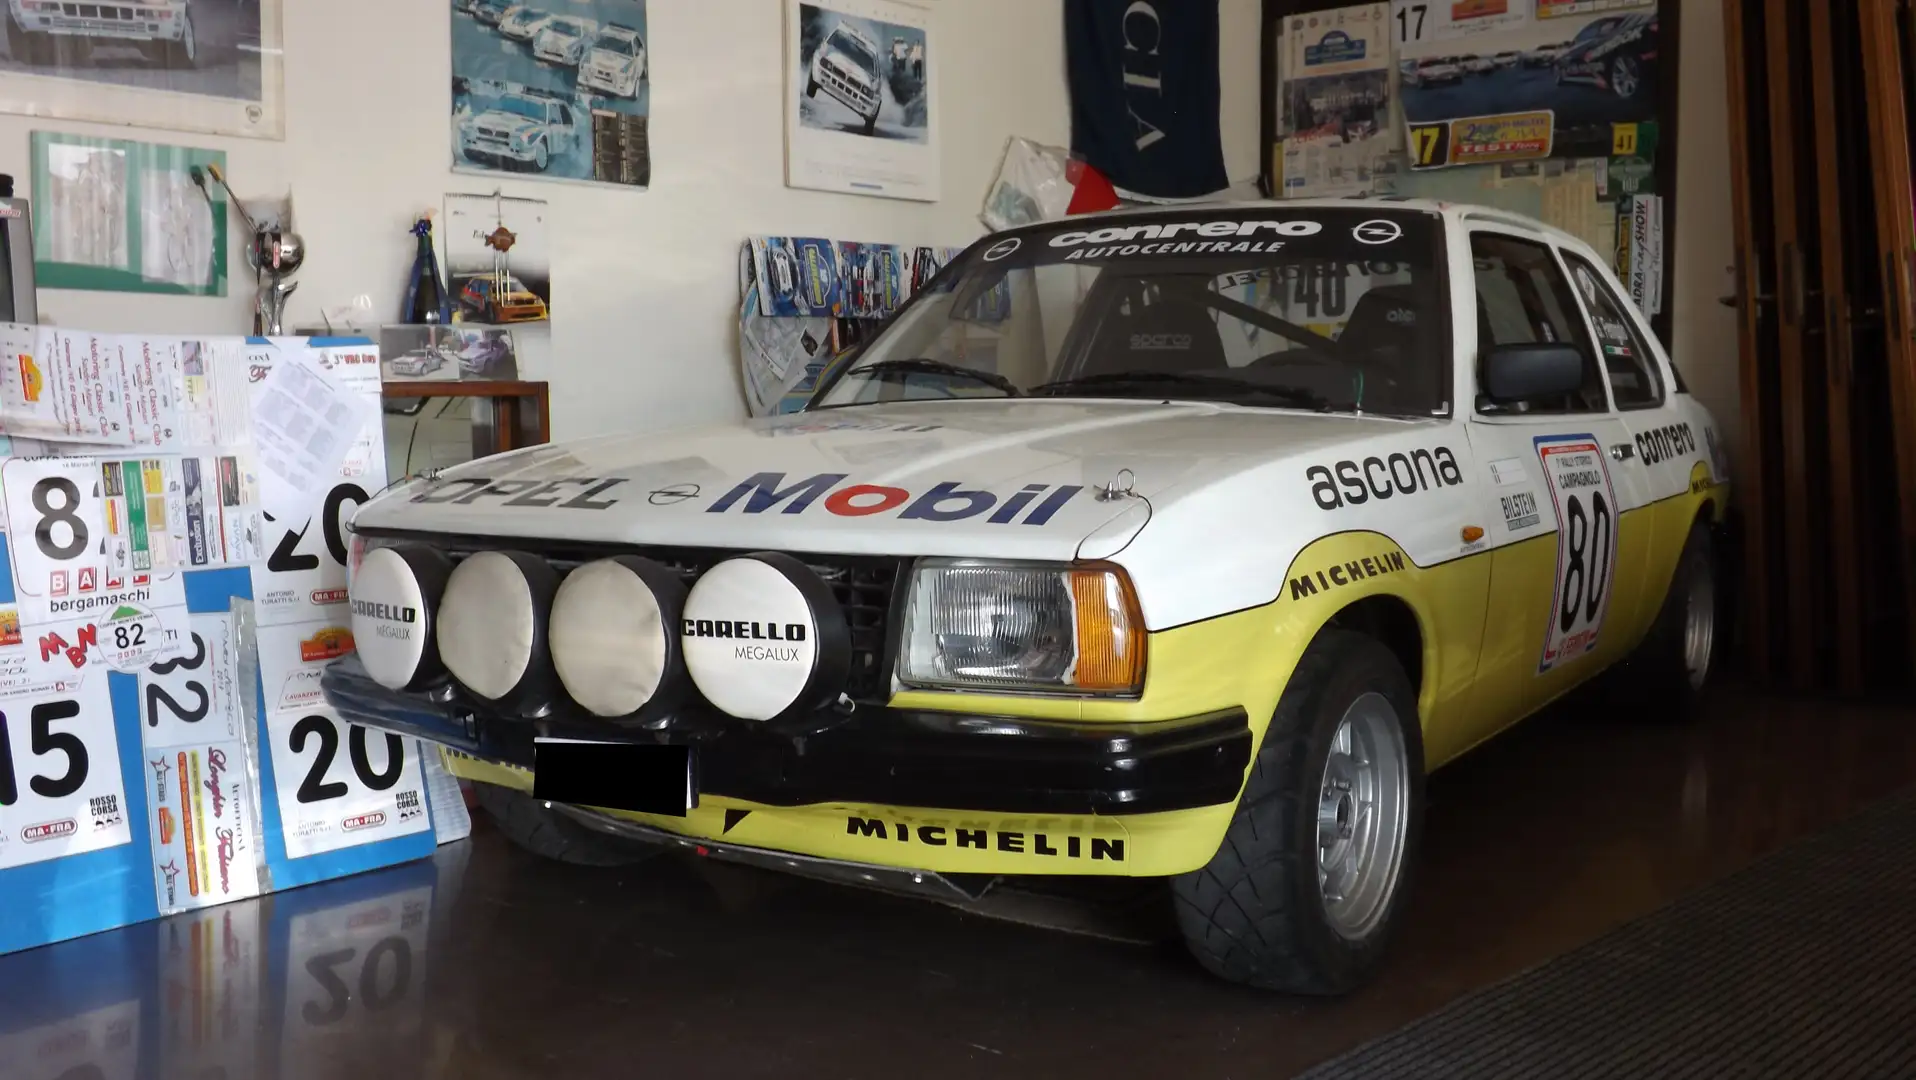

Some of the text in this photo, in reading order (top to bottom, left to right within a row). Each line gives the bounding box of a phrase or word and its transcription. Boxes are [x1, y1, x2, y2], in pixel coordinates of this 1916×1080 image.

[1396, 5, 1427, 42] 17
[1048, 221, 1323, 247] conrero
[1064, 242, 1286, 260] AUTOCENTRALE
[1130, 333, 1192, 347] sparco
[1635, 422, 1696, 466] conrero
[1306, 446, 1464, 511] ascona
[1558, 470, 1601, 490] CAMPAGNOLO
[409, 478, 630, 510] OPEL
[706, 472, 1084, 526] Mobil
[1500, 492, 1538, 520] BILSTEIN
[194, 519, 204, 564] Exclusion
[1290, 551, 1405, 600] MICHELIN
[1560, 491, 1610, 634] 80
[50, 588, 150, 613] bergamaschi
[351, 600, 416, 622] CARELLO
[115, 623, 146, 650] 82
[682, 619, 806, 641] CARELLO
[734, 645, 800, 662] MEGALUX
[289, 715, 404, 804] 20
[90, 794, 116, 808] ROSSO
[395, 790, 418, 801] ROSSO
[396, 798, 419, 810] CORSA
[91, 805, 118, 816] CORSA
[846, 816, 1124, 862] MICHELIN
